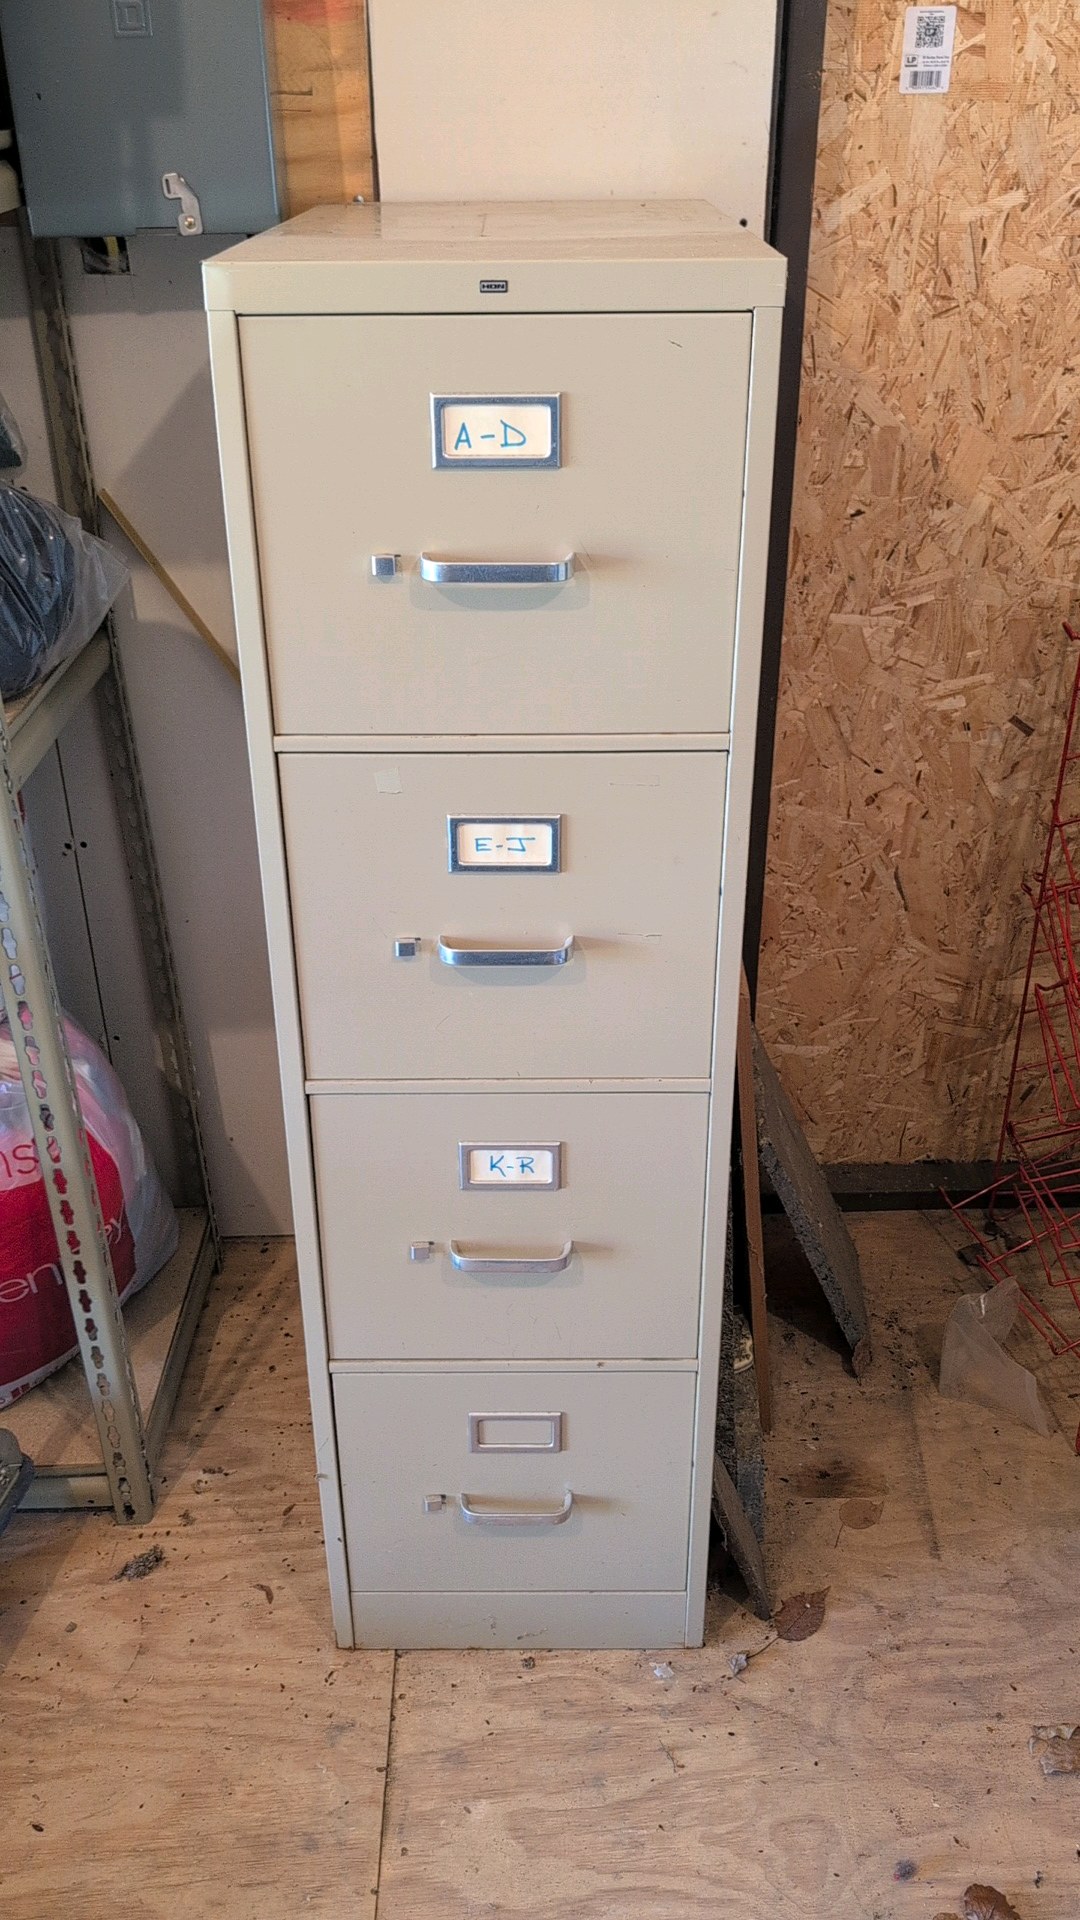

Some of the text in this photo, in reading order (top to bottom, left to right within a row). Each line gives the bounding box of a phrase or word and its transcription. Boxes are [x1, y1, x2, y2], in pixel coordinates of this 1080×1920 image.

[906, 56, 917, 64] LP
[474, 837, 536, 853] E-J
[489, 1155, 535, 1178] K-R
